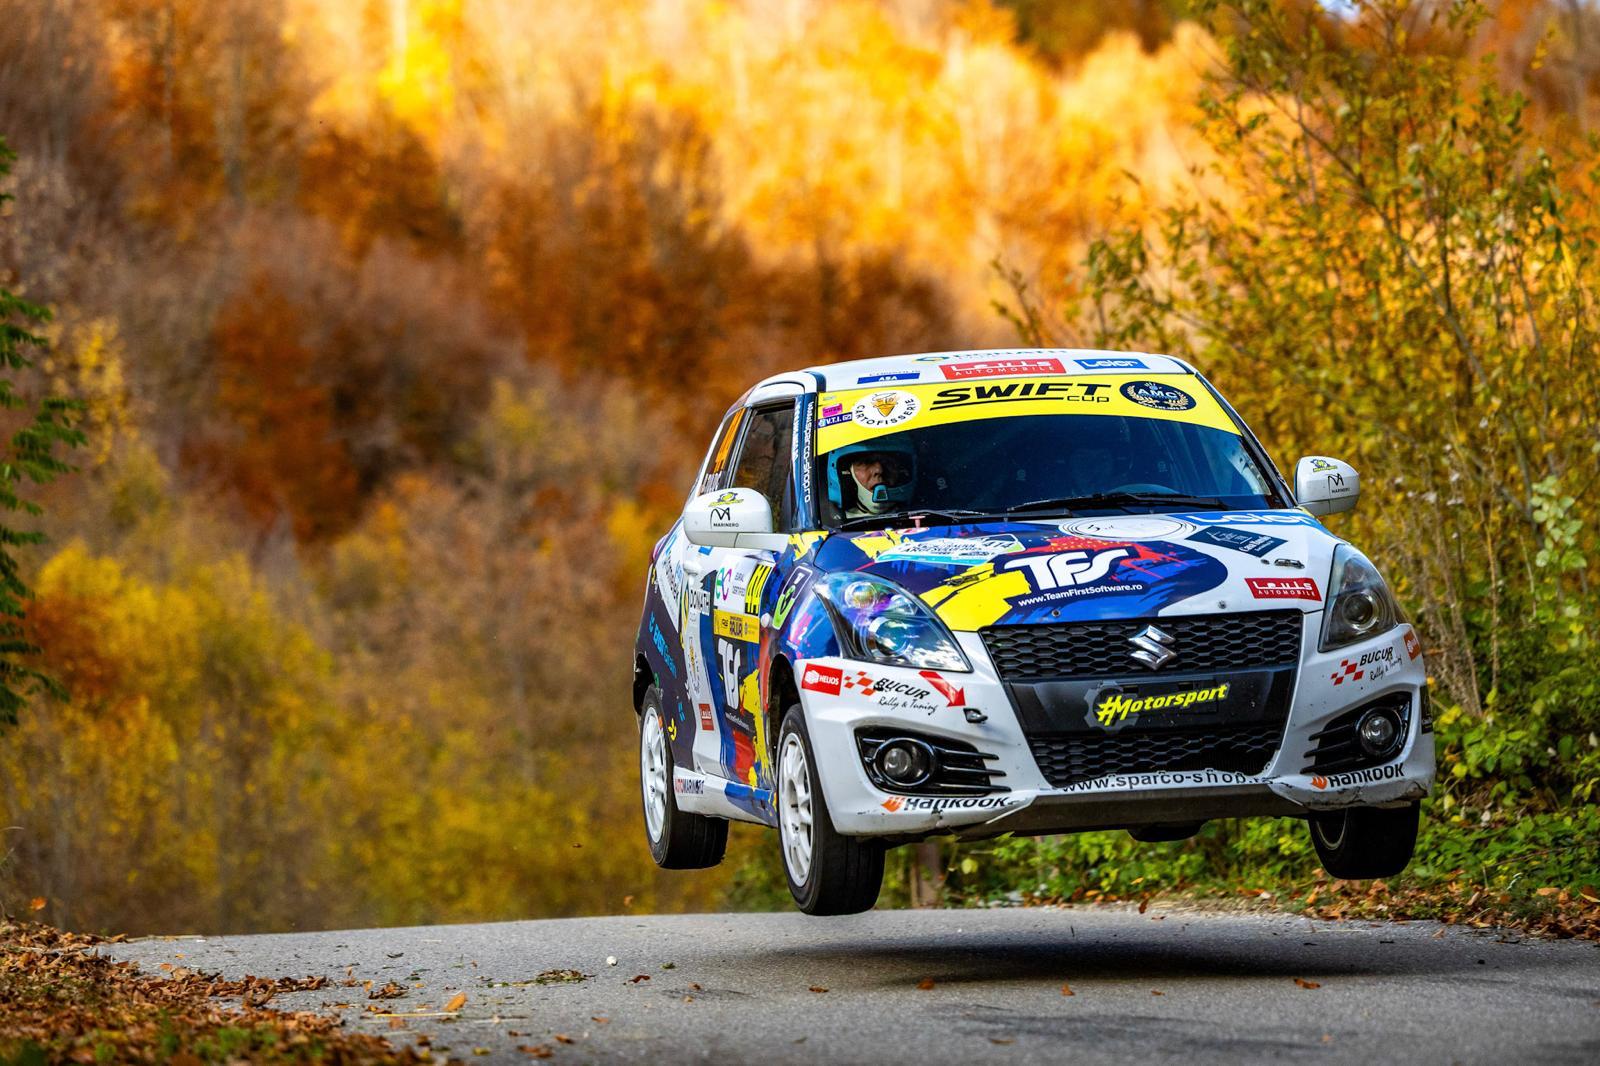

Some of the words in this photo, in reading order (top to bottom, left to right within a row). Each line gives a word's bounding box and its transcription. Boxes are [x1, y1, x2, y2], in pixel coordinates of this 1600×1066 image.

[955, 365, 1055, 376] AUTOMOBILE
[933, 382, 1111, 405] SWIFT
[1137, 388, 1178, 399] AMC
[1004, 548, 1130, 591] TFS
[1018, 584, 1143, 607] www.TeamFirstSoftware.ro
[1258, 589, 1316, 597] AUTOMOBILE
[1360, 646, 1394, 667] BUCUR
[819, 675, 839, 686] HELIOS
[876, 677, 931, 700] BUCUR
[878, 696, 899, 711] Rally
[1097, 684, 1228, 727] #Motorsport
